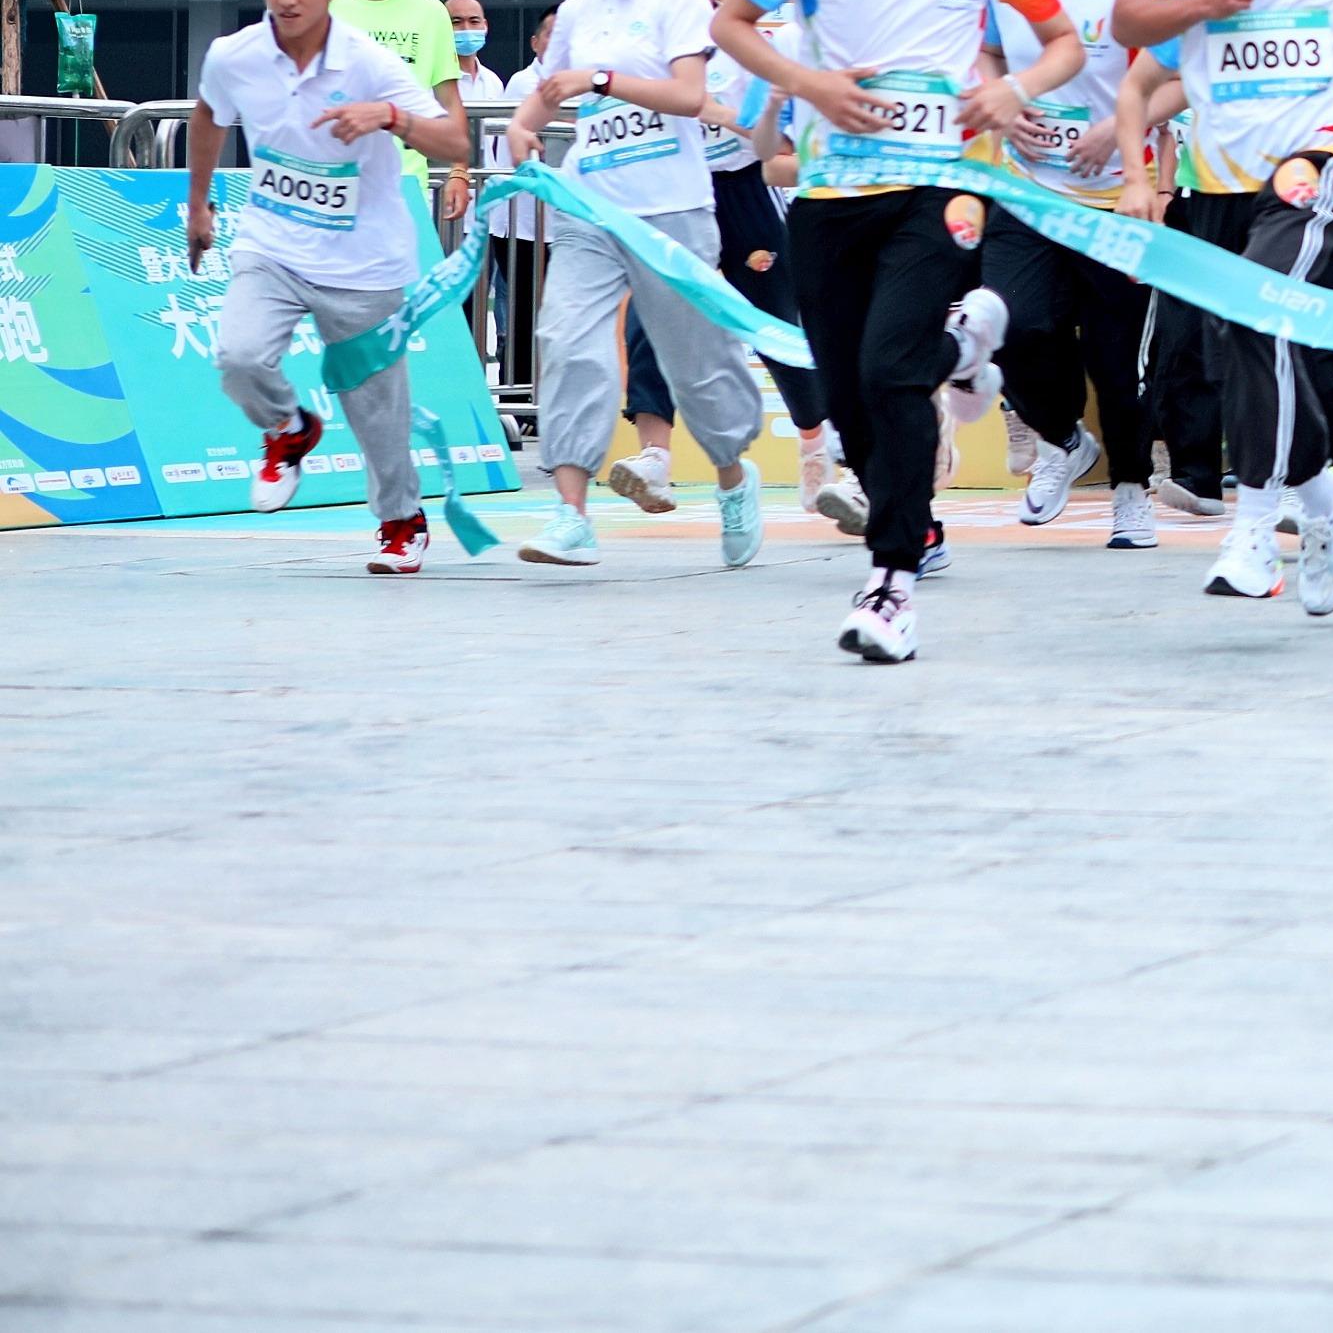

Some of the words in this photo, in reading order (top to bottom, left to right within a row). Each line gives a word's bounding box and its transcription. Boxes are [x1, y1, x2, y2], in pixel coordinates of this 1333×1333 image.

[1221, 38, 1321, 72] A0803
[586, 110, 665, 149] A0034
[259, 169, 348, 209] A0035
